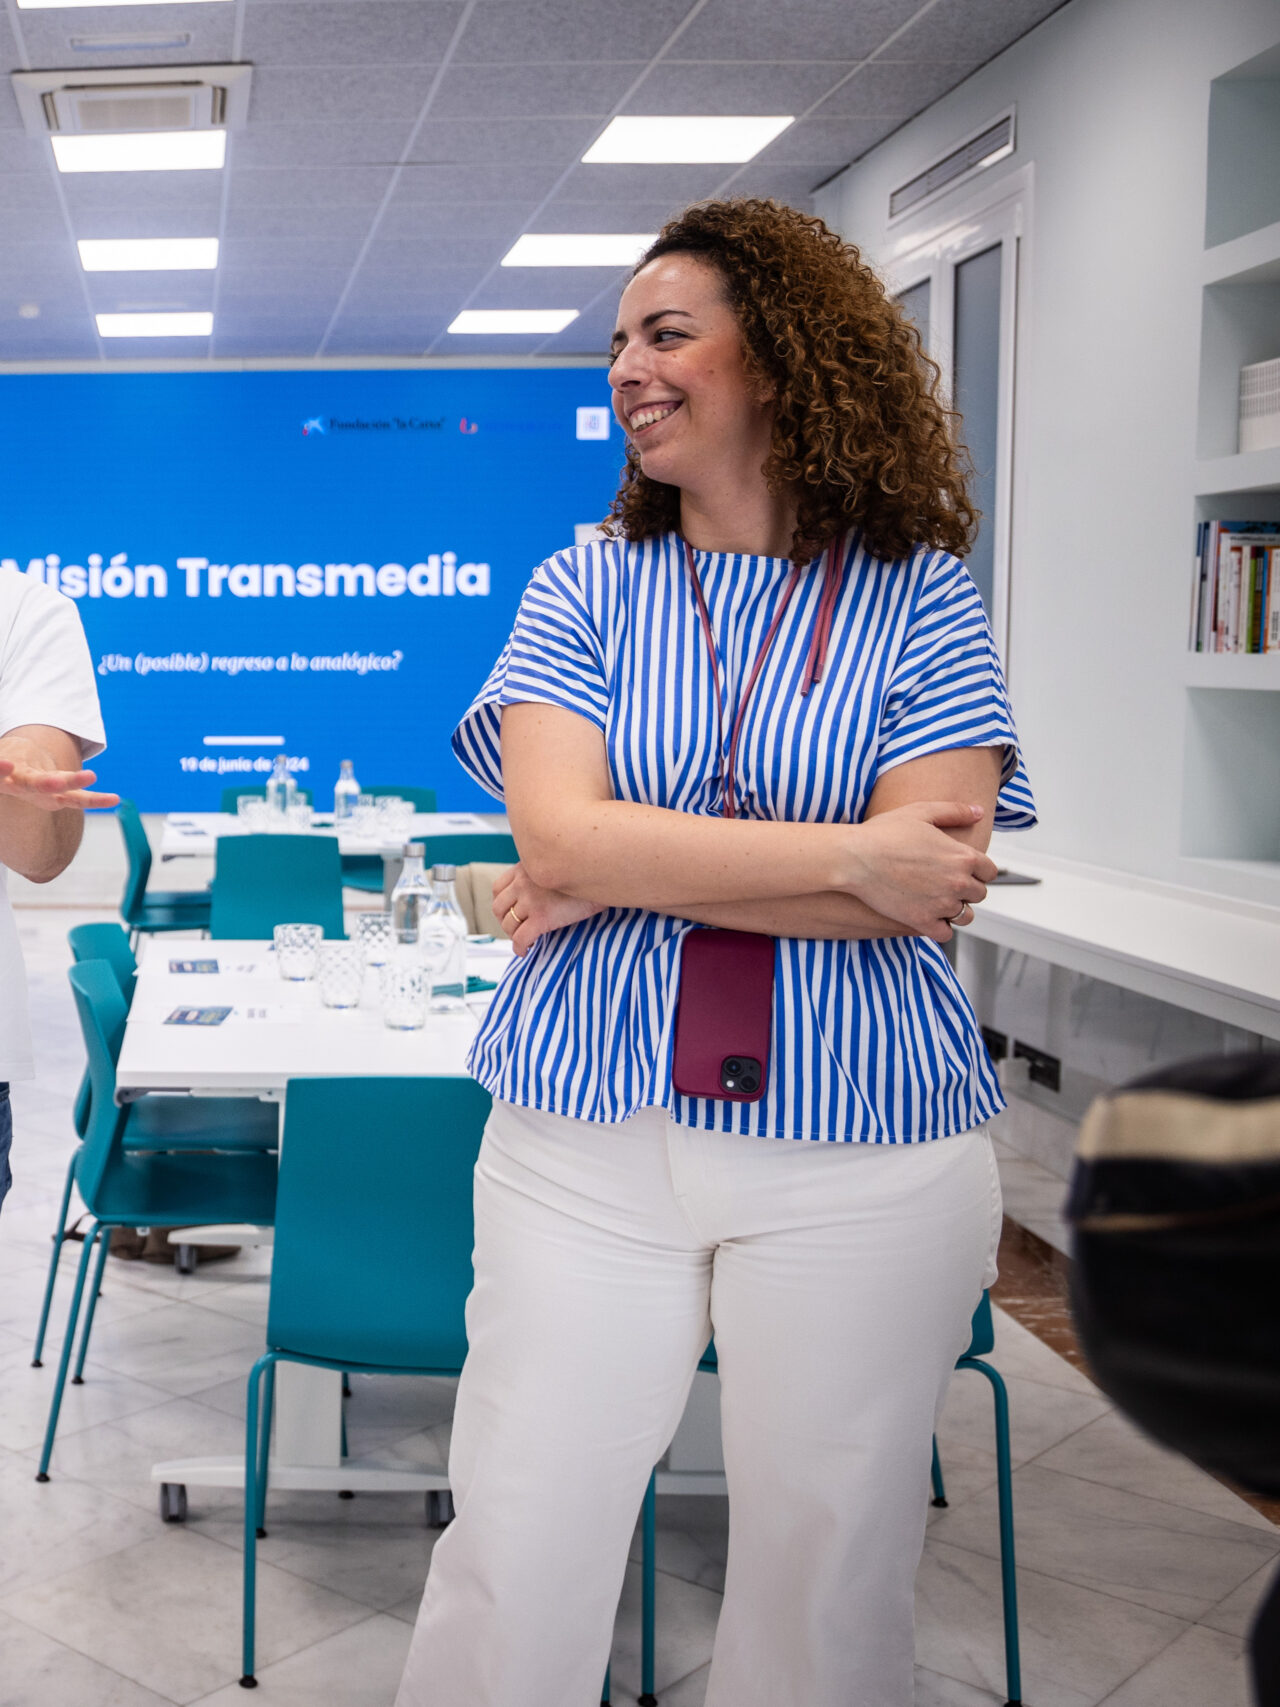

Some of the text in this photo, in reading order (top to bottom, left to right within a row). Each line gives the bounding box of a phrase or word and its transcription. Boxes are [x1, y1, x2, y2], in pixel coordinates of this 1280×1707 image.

[176, 551, 491, 598] Transmedia
[97, 649, 404, 676] ¿Un (posible) regreso a lo analógico?
[179, 755, 310, 776] 19 de junio de 24
